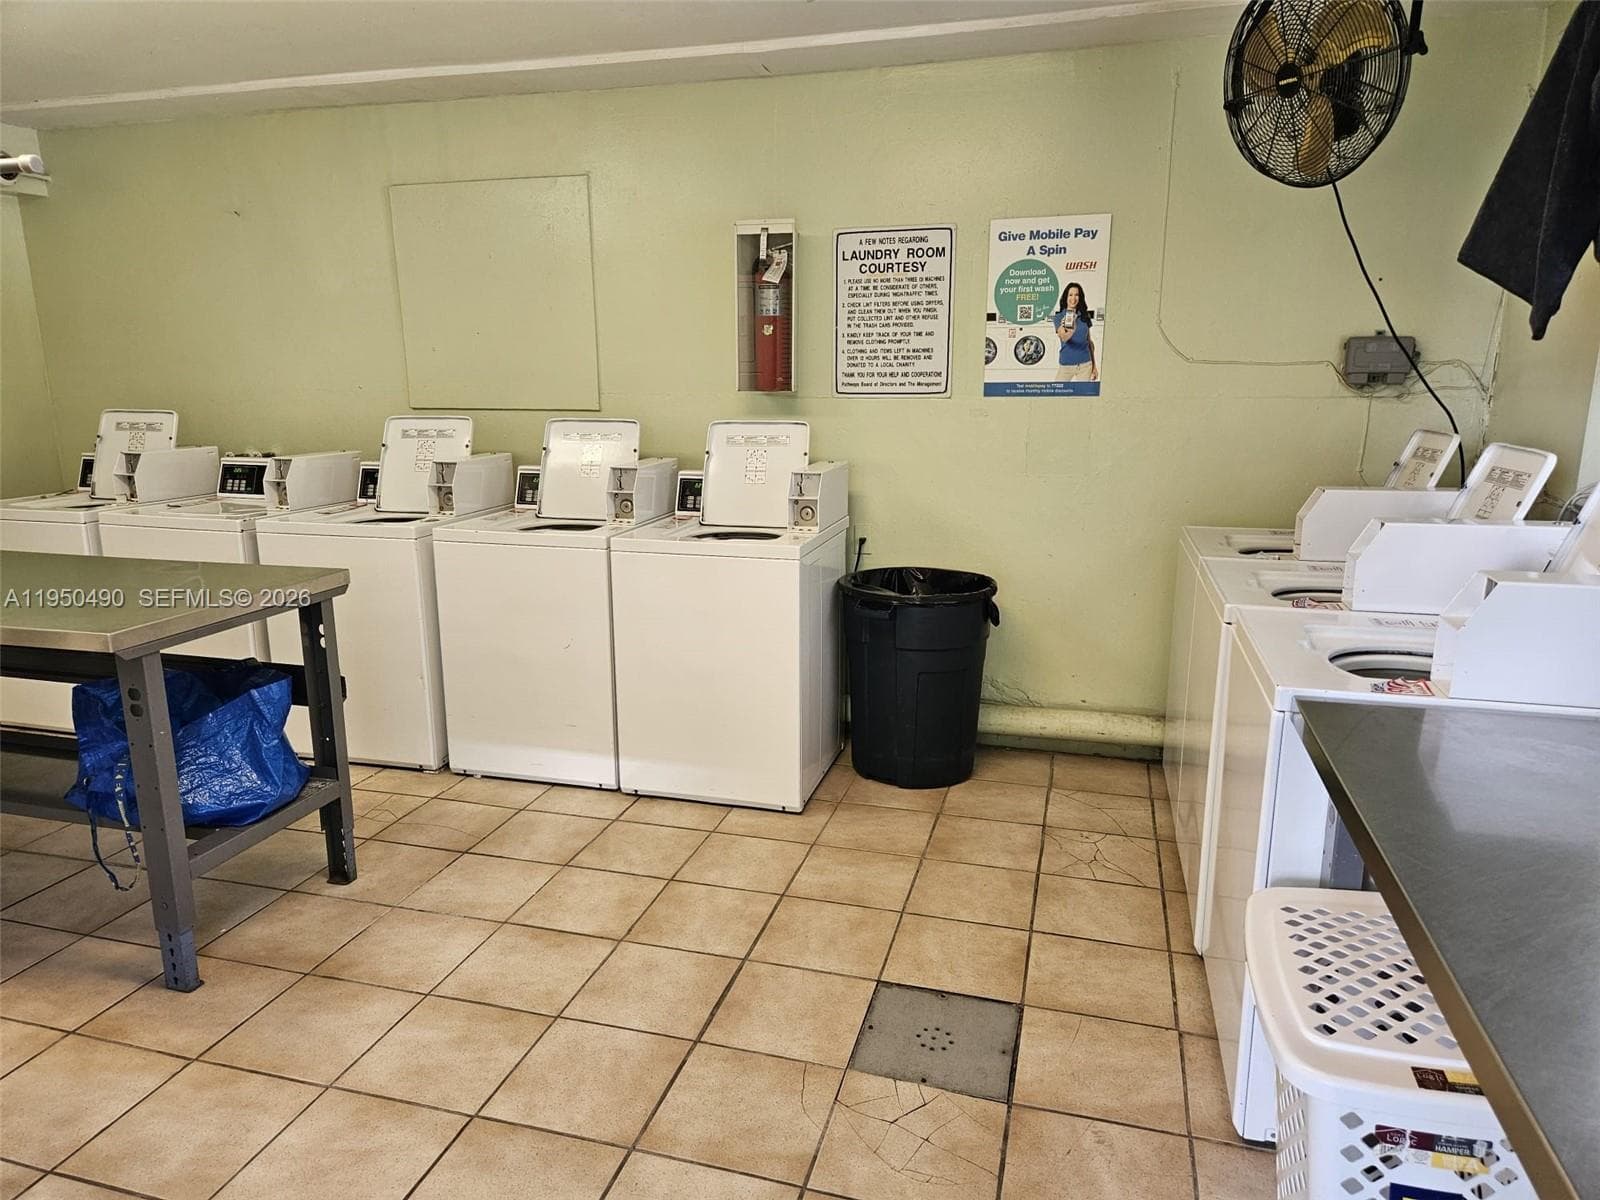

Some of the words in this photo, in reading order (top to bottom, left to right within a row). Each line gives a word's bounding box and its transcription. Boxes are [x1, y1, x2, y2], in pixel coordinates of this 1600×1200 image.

[998, 231, 1026, 242] Give
[1029, 228, 1071, 240] Mobile
[1074, 227, 1098, 239] Pay
[898, 236, 929, 244] REGARDING
[842, 248, 900, 261] LAUNDRY
[907, 247, 946, 258] ROOM
[1026, 245, 1036, 255] A
[1039, 244, 1067, 256] Spin
[859, 261, 927, 274] COURTESY
[1065, 261, 1097, 270] WASH
[1009, 268, 1047, 276] Download
[1022, 276, 1037, 284] and
[1037, 277, 1050, 285] get
[1016, 293, 1039, 301] FREE!
[1386, 1134, 1418, 1146] LOC
[1435, 1145, 1470, 1155] HAMPER
